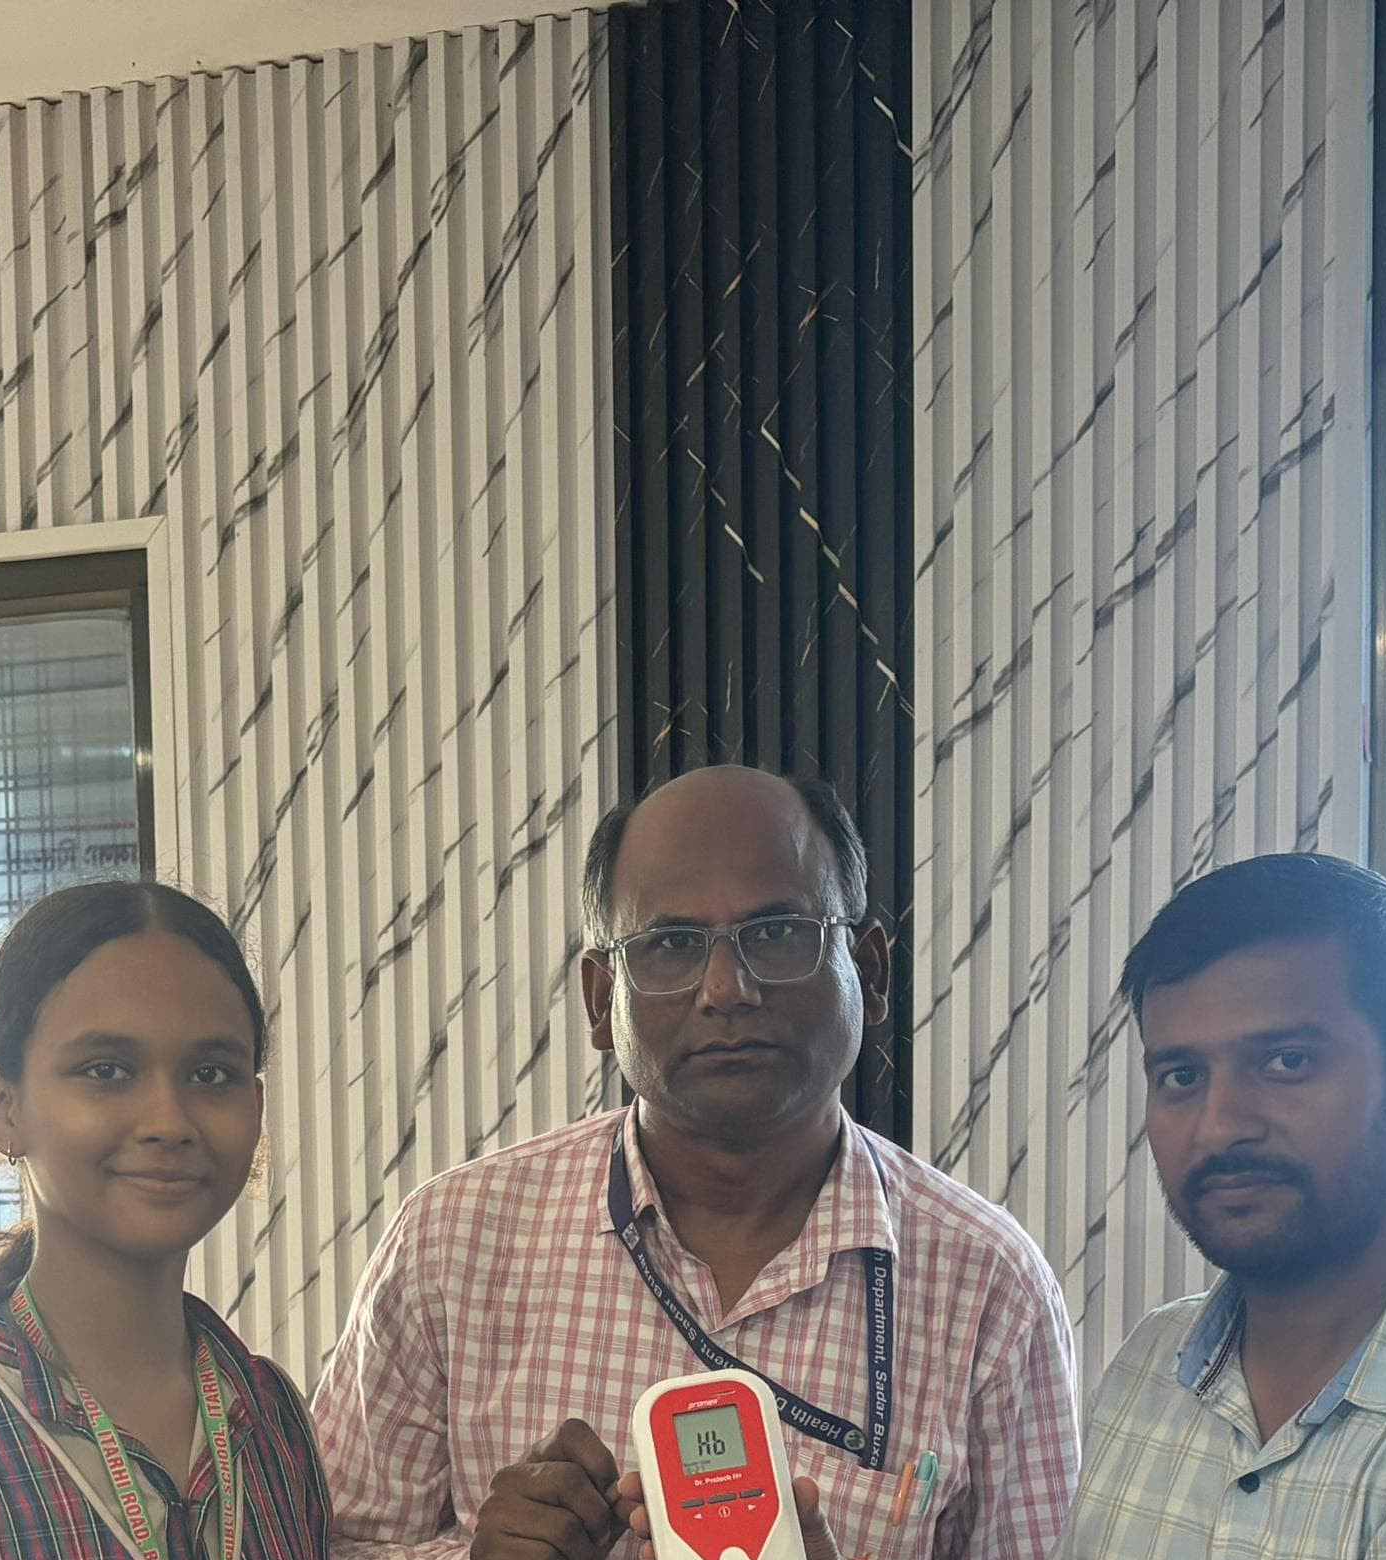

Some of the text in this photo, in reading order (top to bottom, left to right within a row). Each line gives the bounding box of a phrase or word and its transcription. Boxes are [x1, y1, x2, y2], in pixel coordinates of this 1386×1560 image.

[663, 1298, 698, 1342] Sadar
[872, 1266, 887, 1364] Department,
[874, 1370, 888, 1421] Sadar
[697, 1430, 726, 1457] Hb
[790, 1403, 843, 1441] Health
[213, 1423, 233, 1494] SCHOOL,
[869, 1424, 886, 1468] Buxa
[97, 1430, 134, 1491] ITARHI
[121, 1491, 151, 1546] ROAD,
